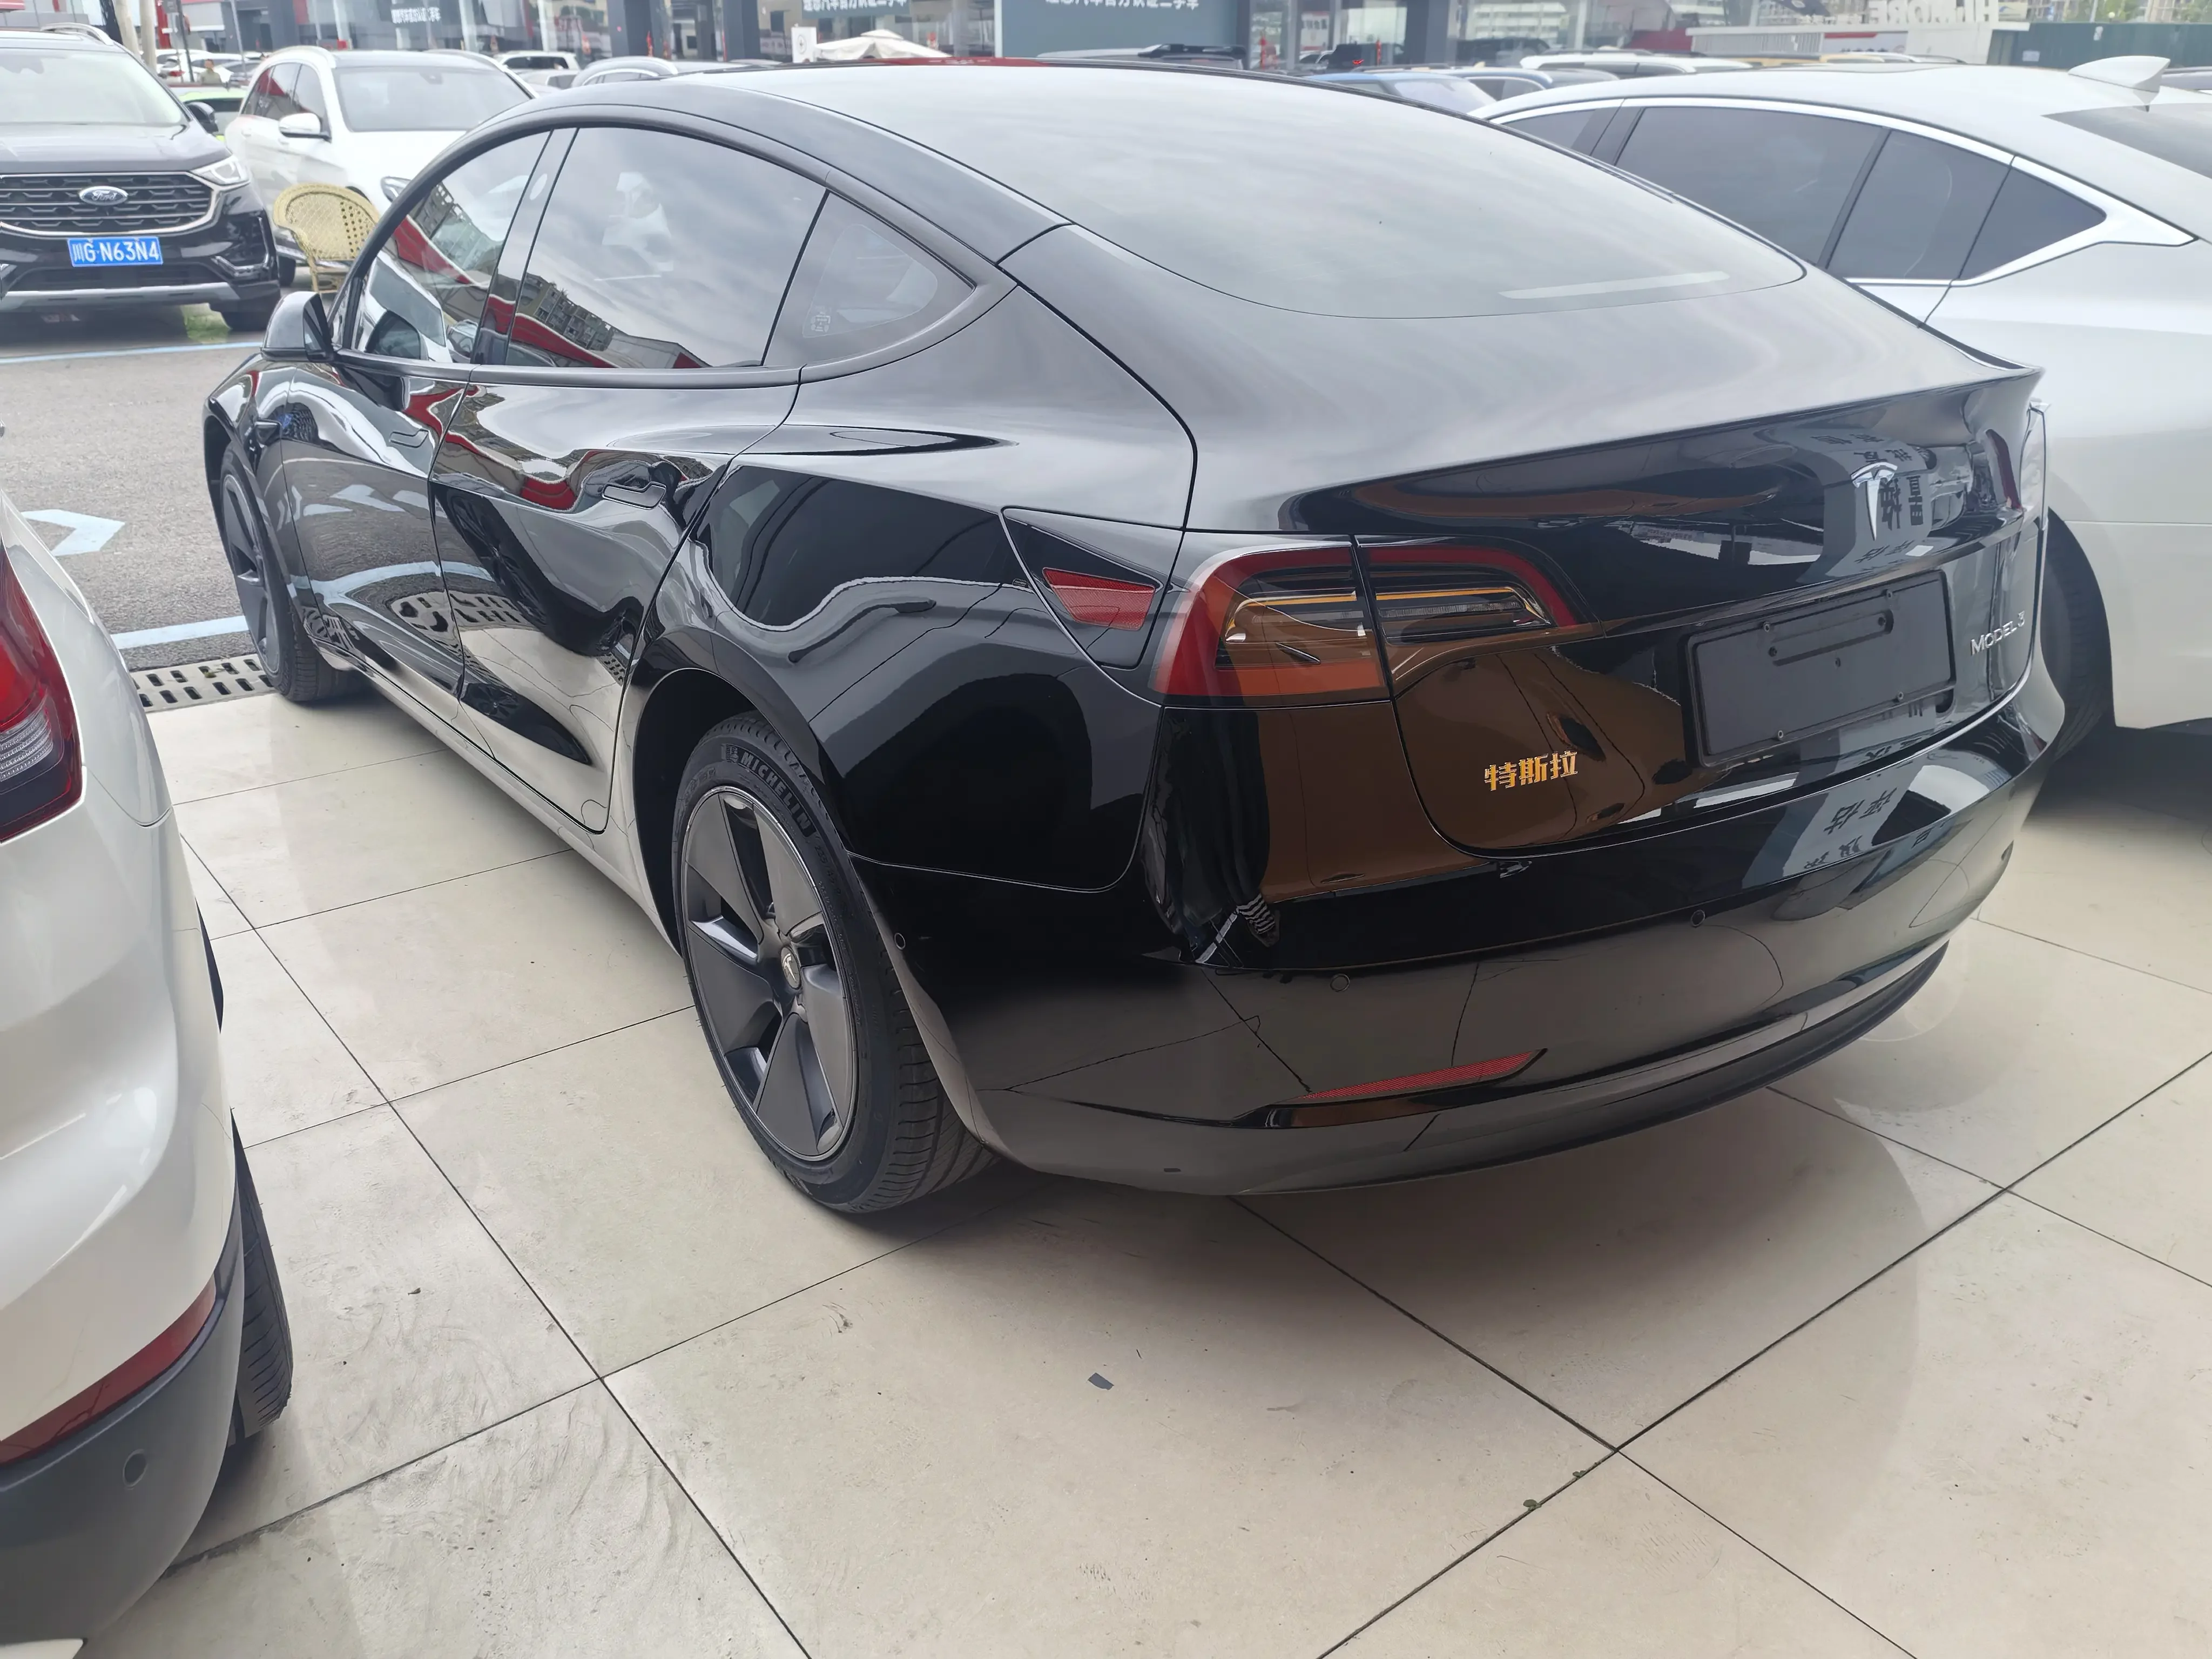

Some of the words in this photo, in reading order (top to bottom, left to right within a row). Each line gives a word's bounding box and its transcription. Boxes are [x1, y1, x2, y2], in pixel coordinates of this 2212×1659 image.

[91, 190, 117, 201] Ford
[1970, 621, 2018, 656] MODEL
[2018, 610, 2025, 627] 3
[740, 751, 810, 830] MICHELIN
[1484, 751, 1578, 791] 特斯拉
